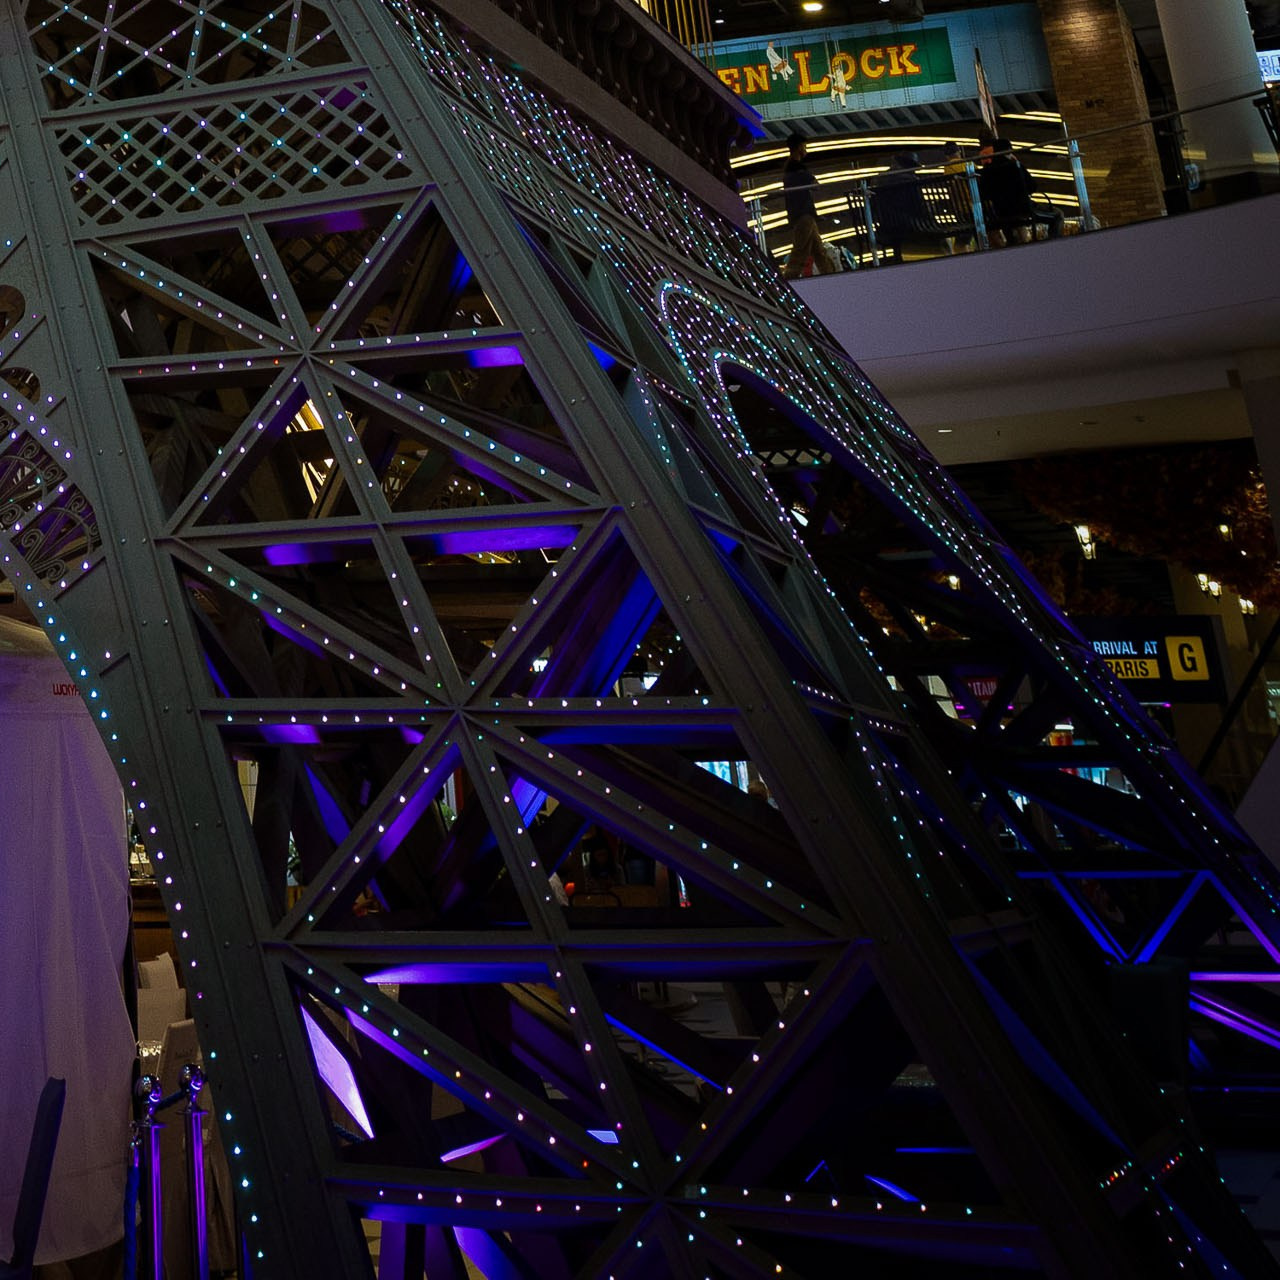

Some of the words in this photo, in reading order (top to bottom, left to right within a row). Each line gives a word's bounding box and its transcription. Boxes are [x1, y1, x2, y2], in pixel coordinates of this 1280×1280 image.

[793, 43, 921, 95] LOCK
[1091, 640, 1139, 656] RRIVAL
[1143, 640, 1158, 655] AT
[1177, 642, 1198, 673] G
